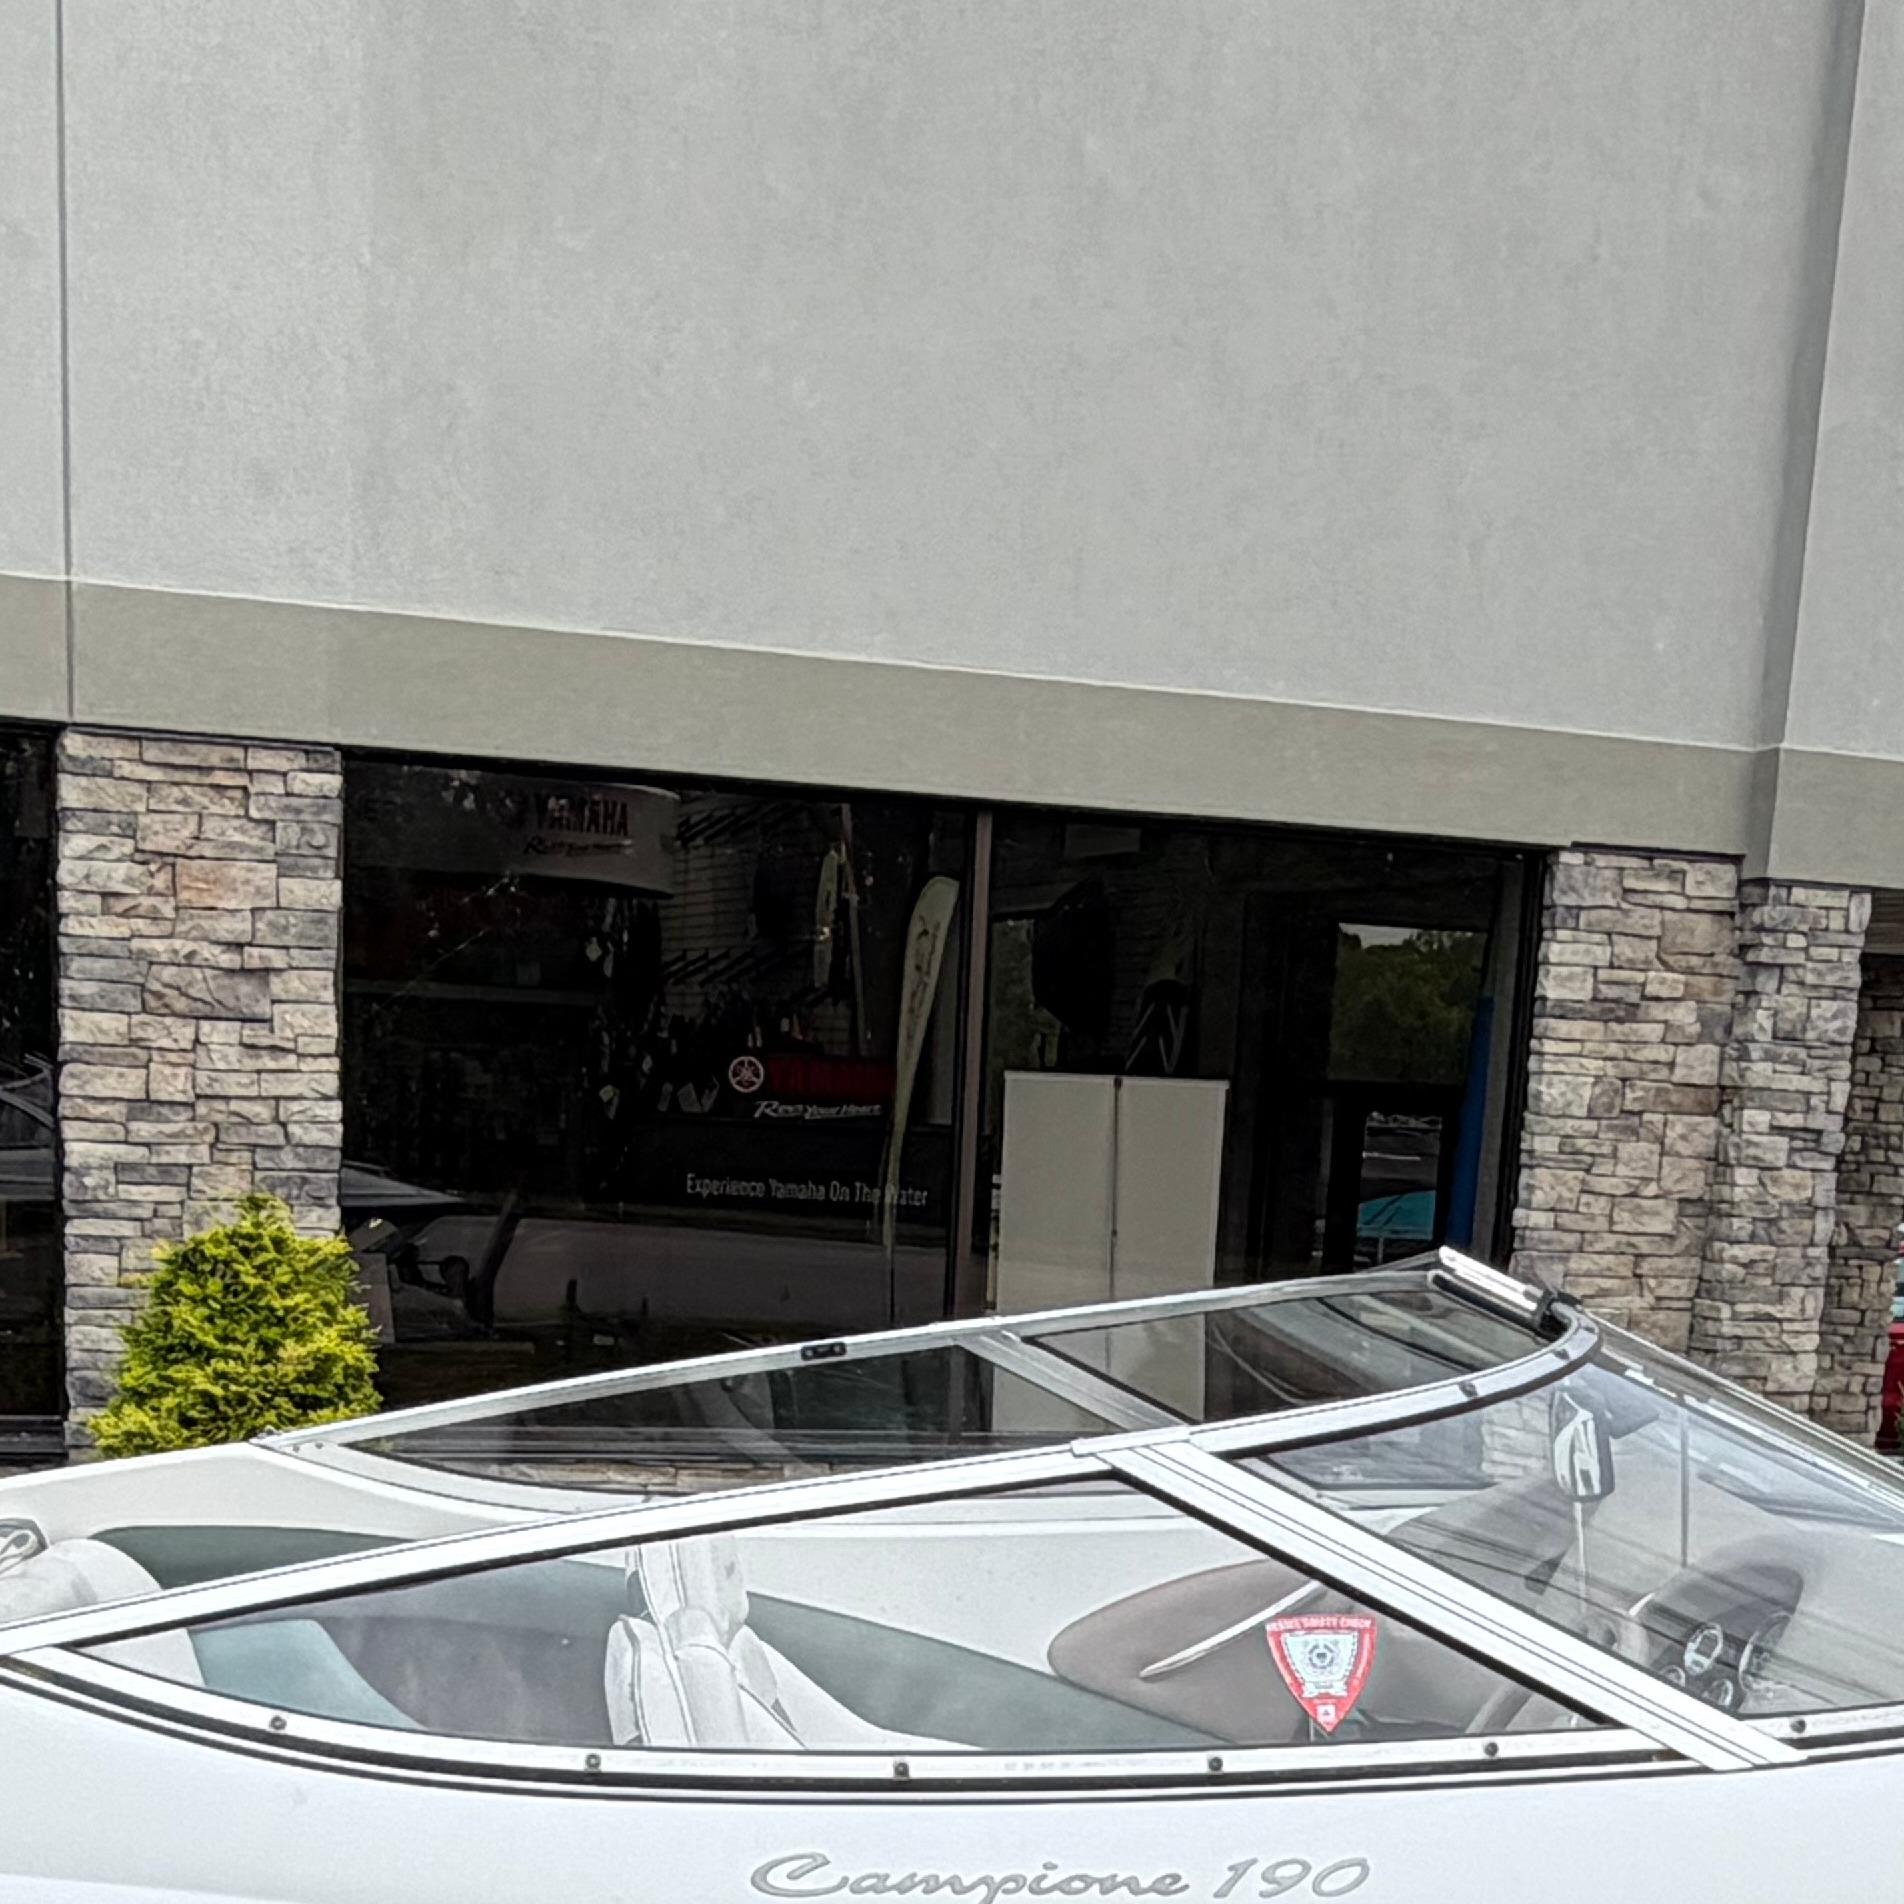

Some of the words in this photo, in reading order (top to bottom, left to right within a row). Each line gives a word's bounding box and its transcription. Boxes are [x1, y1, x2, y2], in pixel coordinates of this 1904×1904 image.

[686, 1171, 766, 1199] Experience
[768, 1177, 826, 1201] Yamaha
[829, 1179, 850, 1203] On
[854, 1181, 882, 1203] The
[1212, 1857, 1371, 1899] 190
